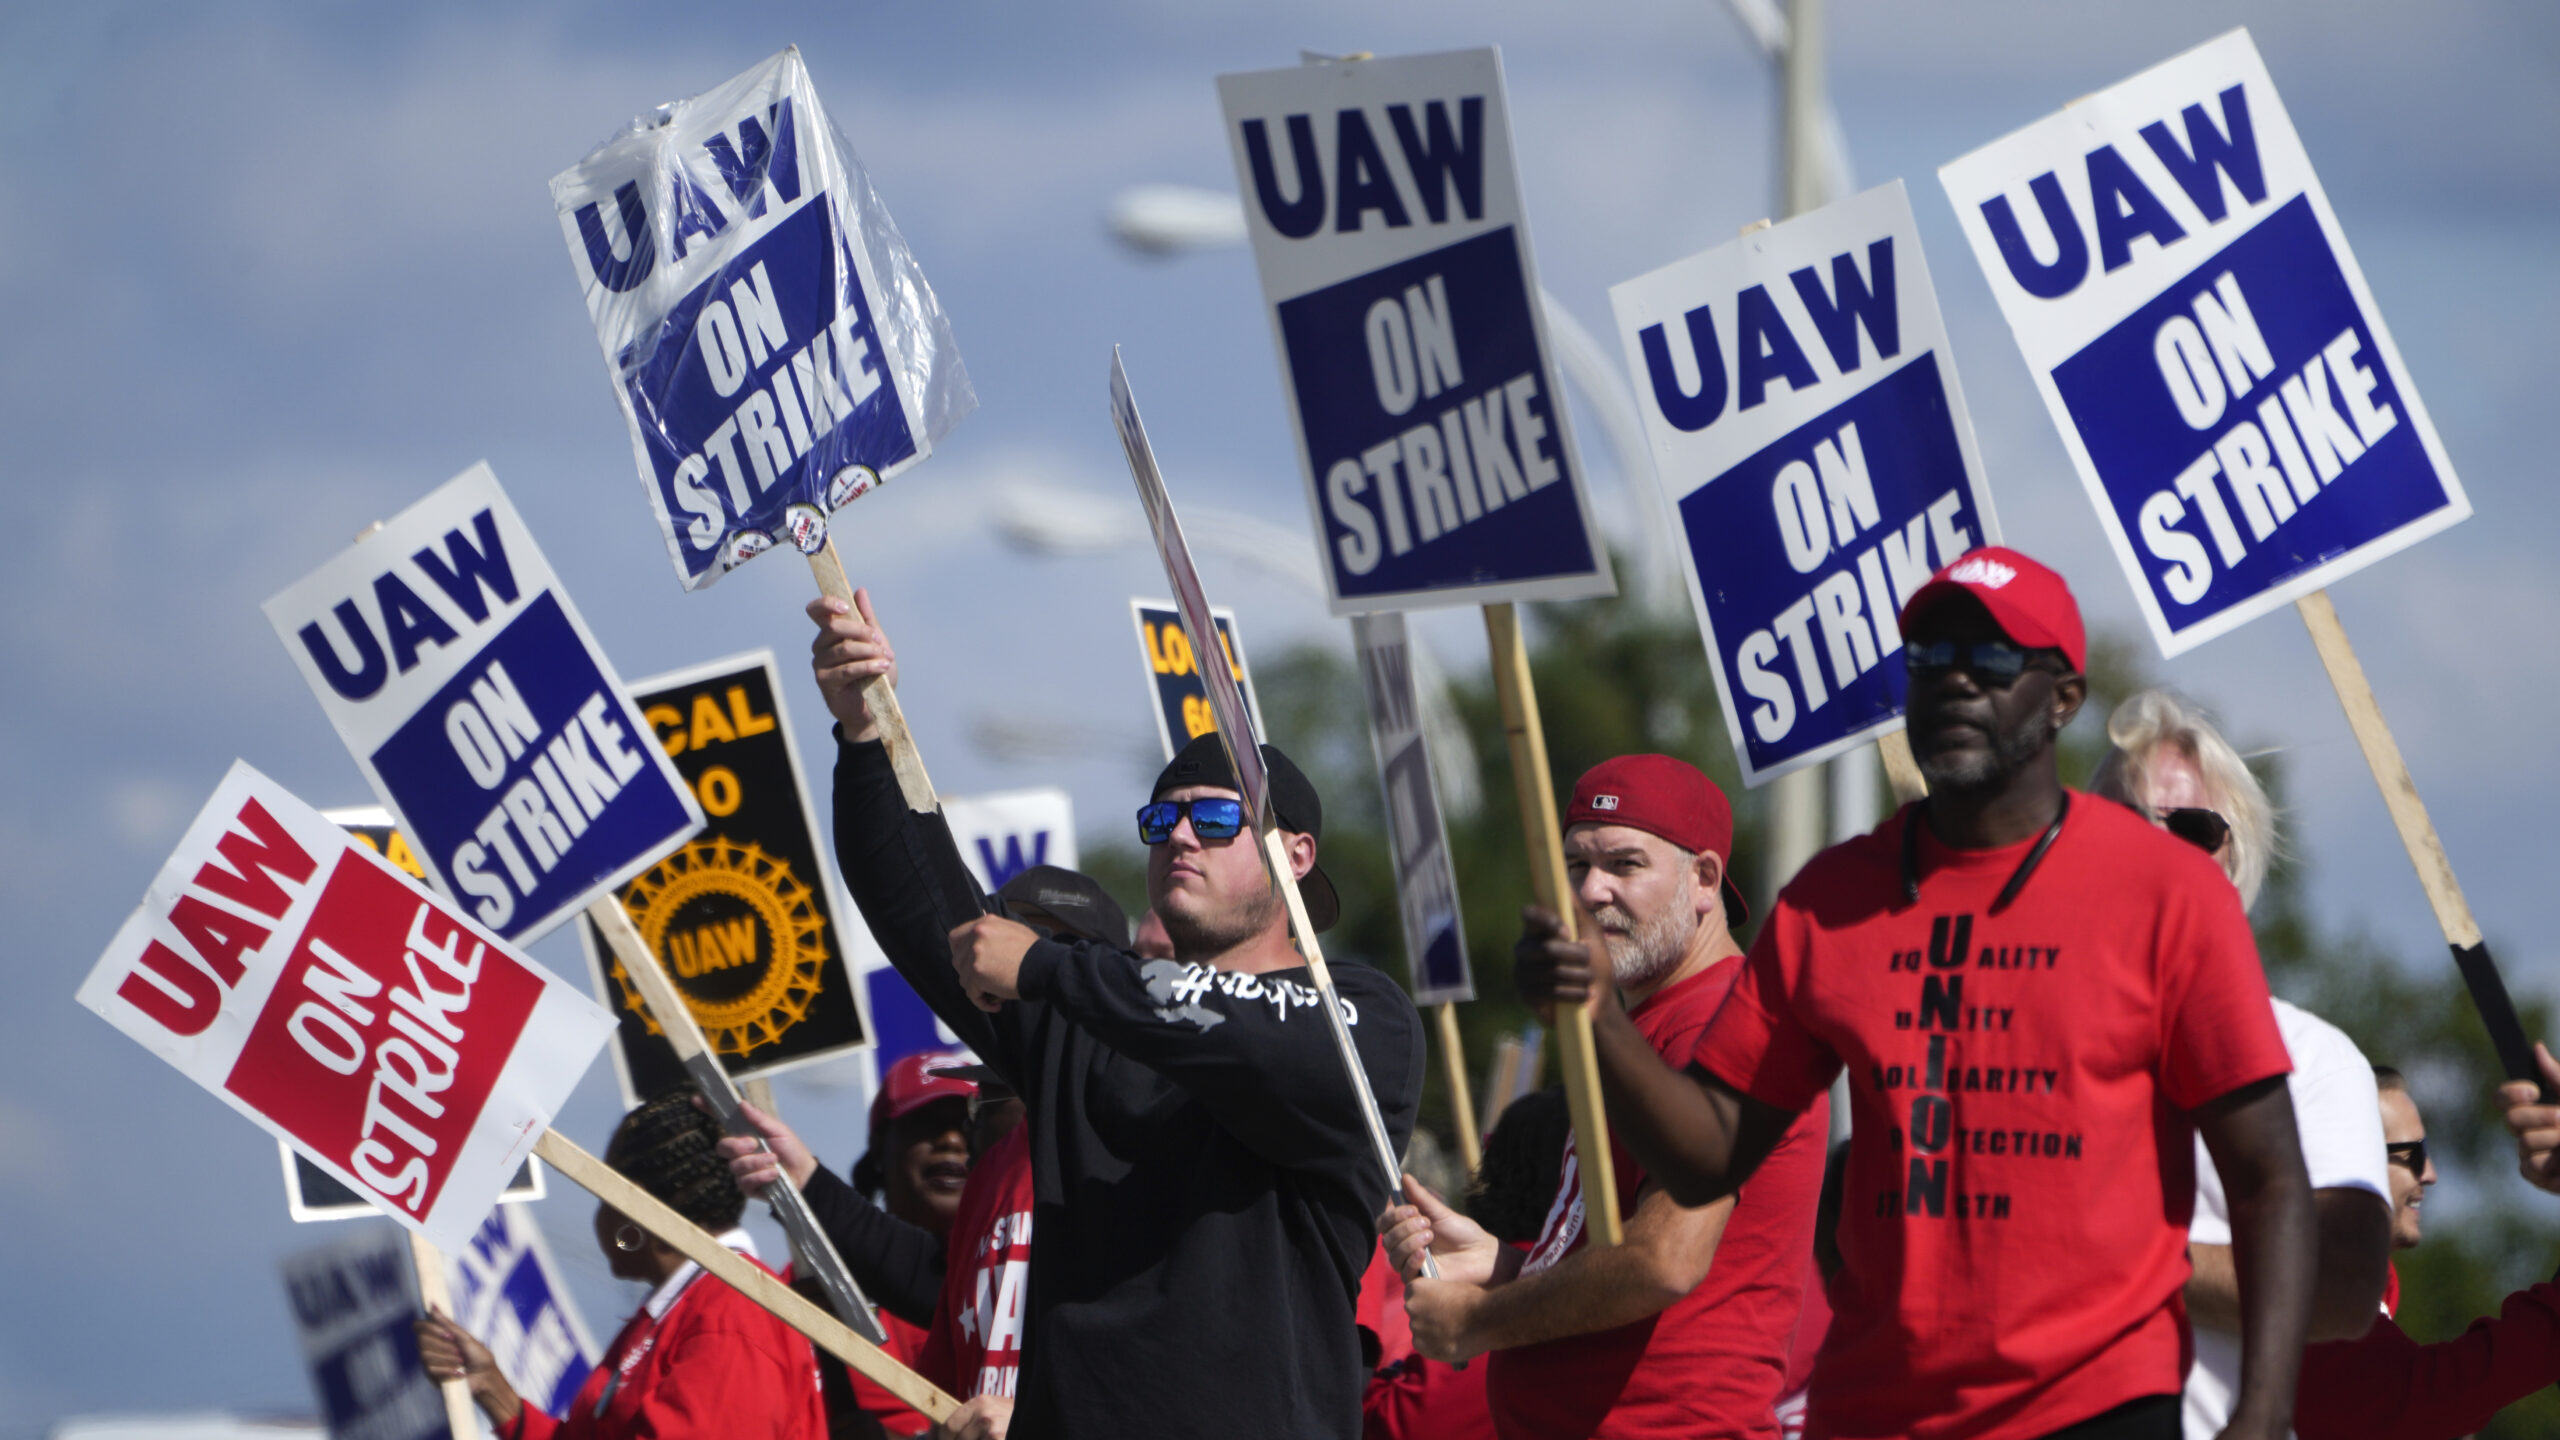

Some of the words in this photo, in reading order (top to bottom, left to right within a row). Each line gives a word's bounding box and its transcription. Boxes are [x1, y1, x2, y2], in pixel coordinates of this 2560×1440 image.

[574, 96, 801, 293] UAW
[1240, 96, 1485, 239] UAW
[1979, 81, 2268, 300] UAW
[697, 260, 788, 397] ON
[1365, 273, 1463, 415] ON
[1638, 236, 1901, 433] UAW
[2153, 270, 2276, 431] ON
[673, 302, 882, 551] STRIKE
[1326, 372, 1560, 575] STRIKE
[1771, 420, 1881, 573] ON
[2138, 327, 2399, 605] STRIKE
[298, 508, 521, 702] UAW
[1144, 621, 1244, 682] LOL
[1737, 488, 1971, 743] STRIKE
[444, 661, 542, 790] ON
[451, 692, 645, 931] STRIKE
[644, 684, 775, 758] CAL
[116, 795, 319, 1037] UAW
[286, 939, 382, 1075] ON
[669, 914, 757, 979] UAW
[351, 901, 485, 1211] STRIKE
